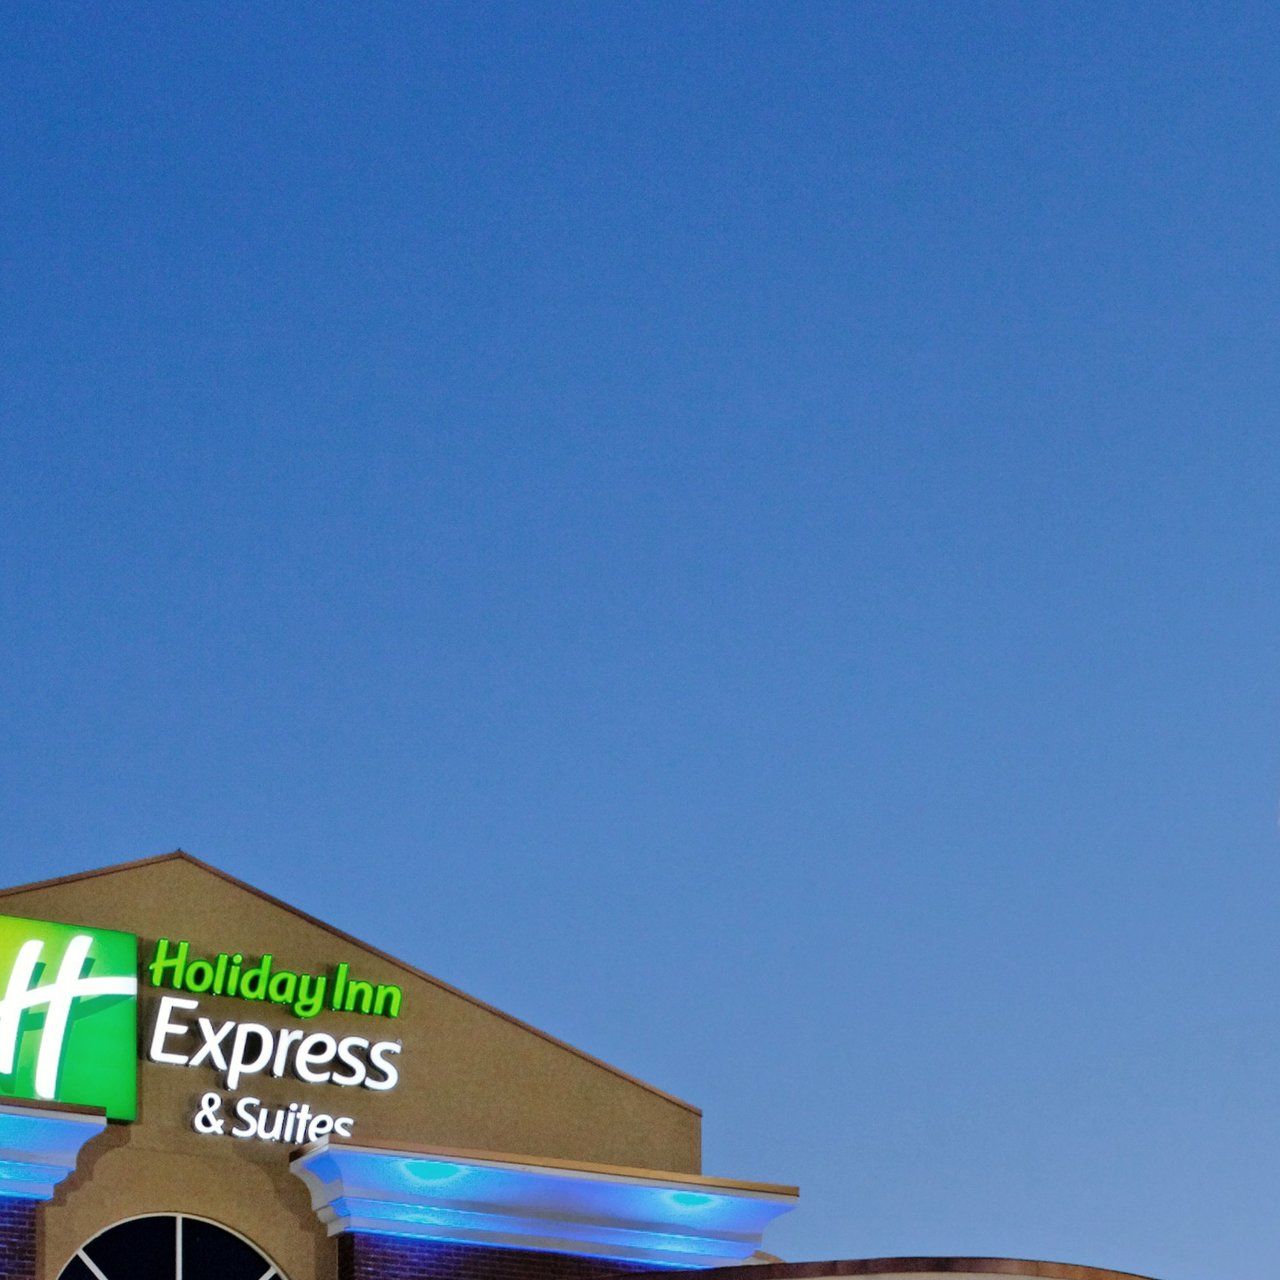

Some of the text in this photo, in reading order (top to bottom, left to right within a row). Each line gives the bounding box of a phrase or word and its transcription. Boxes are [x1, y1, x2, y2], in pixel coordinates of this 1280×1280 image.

[149, 937, 404, 1019] Holiday Inn
[148, 995, 403, 1091] Express
[193, 1091, 225, 1135] &
